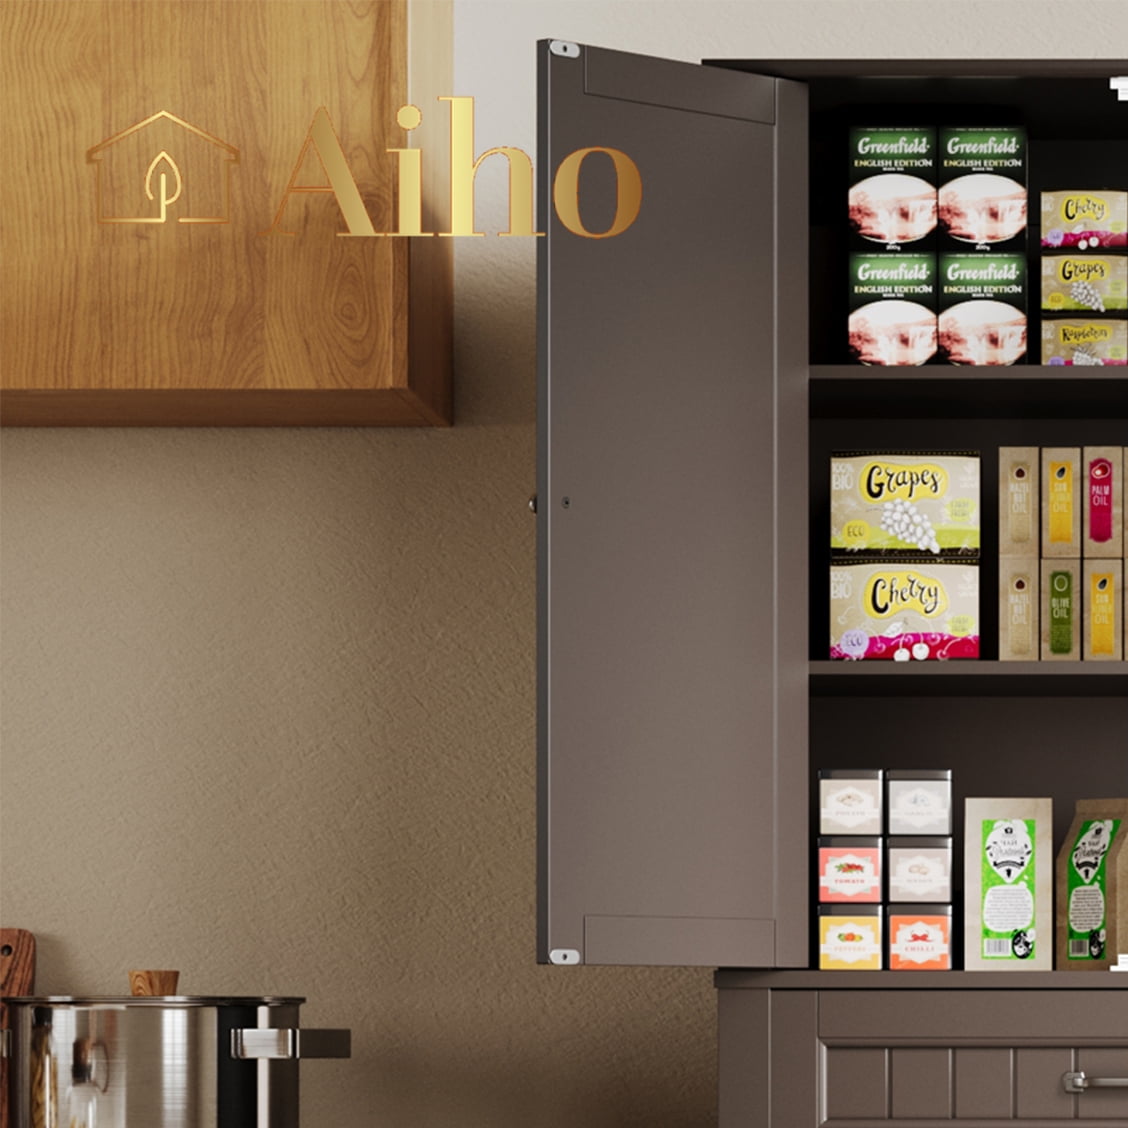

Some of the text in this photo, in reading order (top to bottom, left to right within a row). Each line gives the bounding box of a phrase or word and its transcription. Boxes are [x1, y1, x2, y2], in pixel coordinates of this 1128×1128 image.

[857, 137, 929, 155] Greenfield
[947, 137, 1019, 155] Greenfield
[854, 158, 933, 168] ENGLISH EDITION
[943, 158, 1021, 168] ENGLISH EDITION
[857, 263, 929, 281] Greenfield
[947, 263, 1019, 281] Greenfield
[1062, 260, 1105, 280] Grapes
[854, 285, 933, 294] ENGLISH EDITION
[943, 285, 1021, 294] ENGLISH EDITION
[833, 475, 853, 489] BIO
[866, 465, 940, 499] Grapes
[1092, 485, 1109, 495] PALM
[1093, 496, 1108, 506] OIL
[871, 574, 939, 615] Cherry
[1051, 598, 1070, 608] OLIVE
[1053, 608, 1069, 619] OIL
